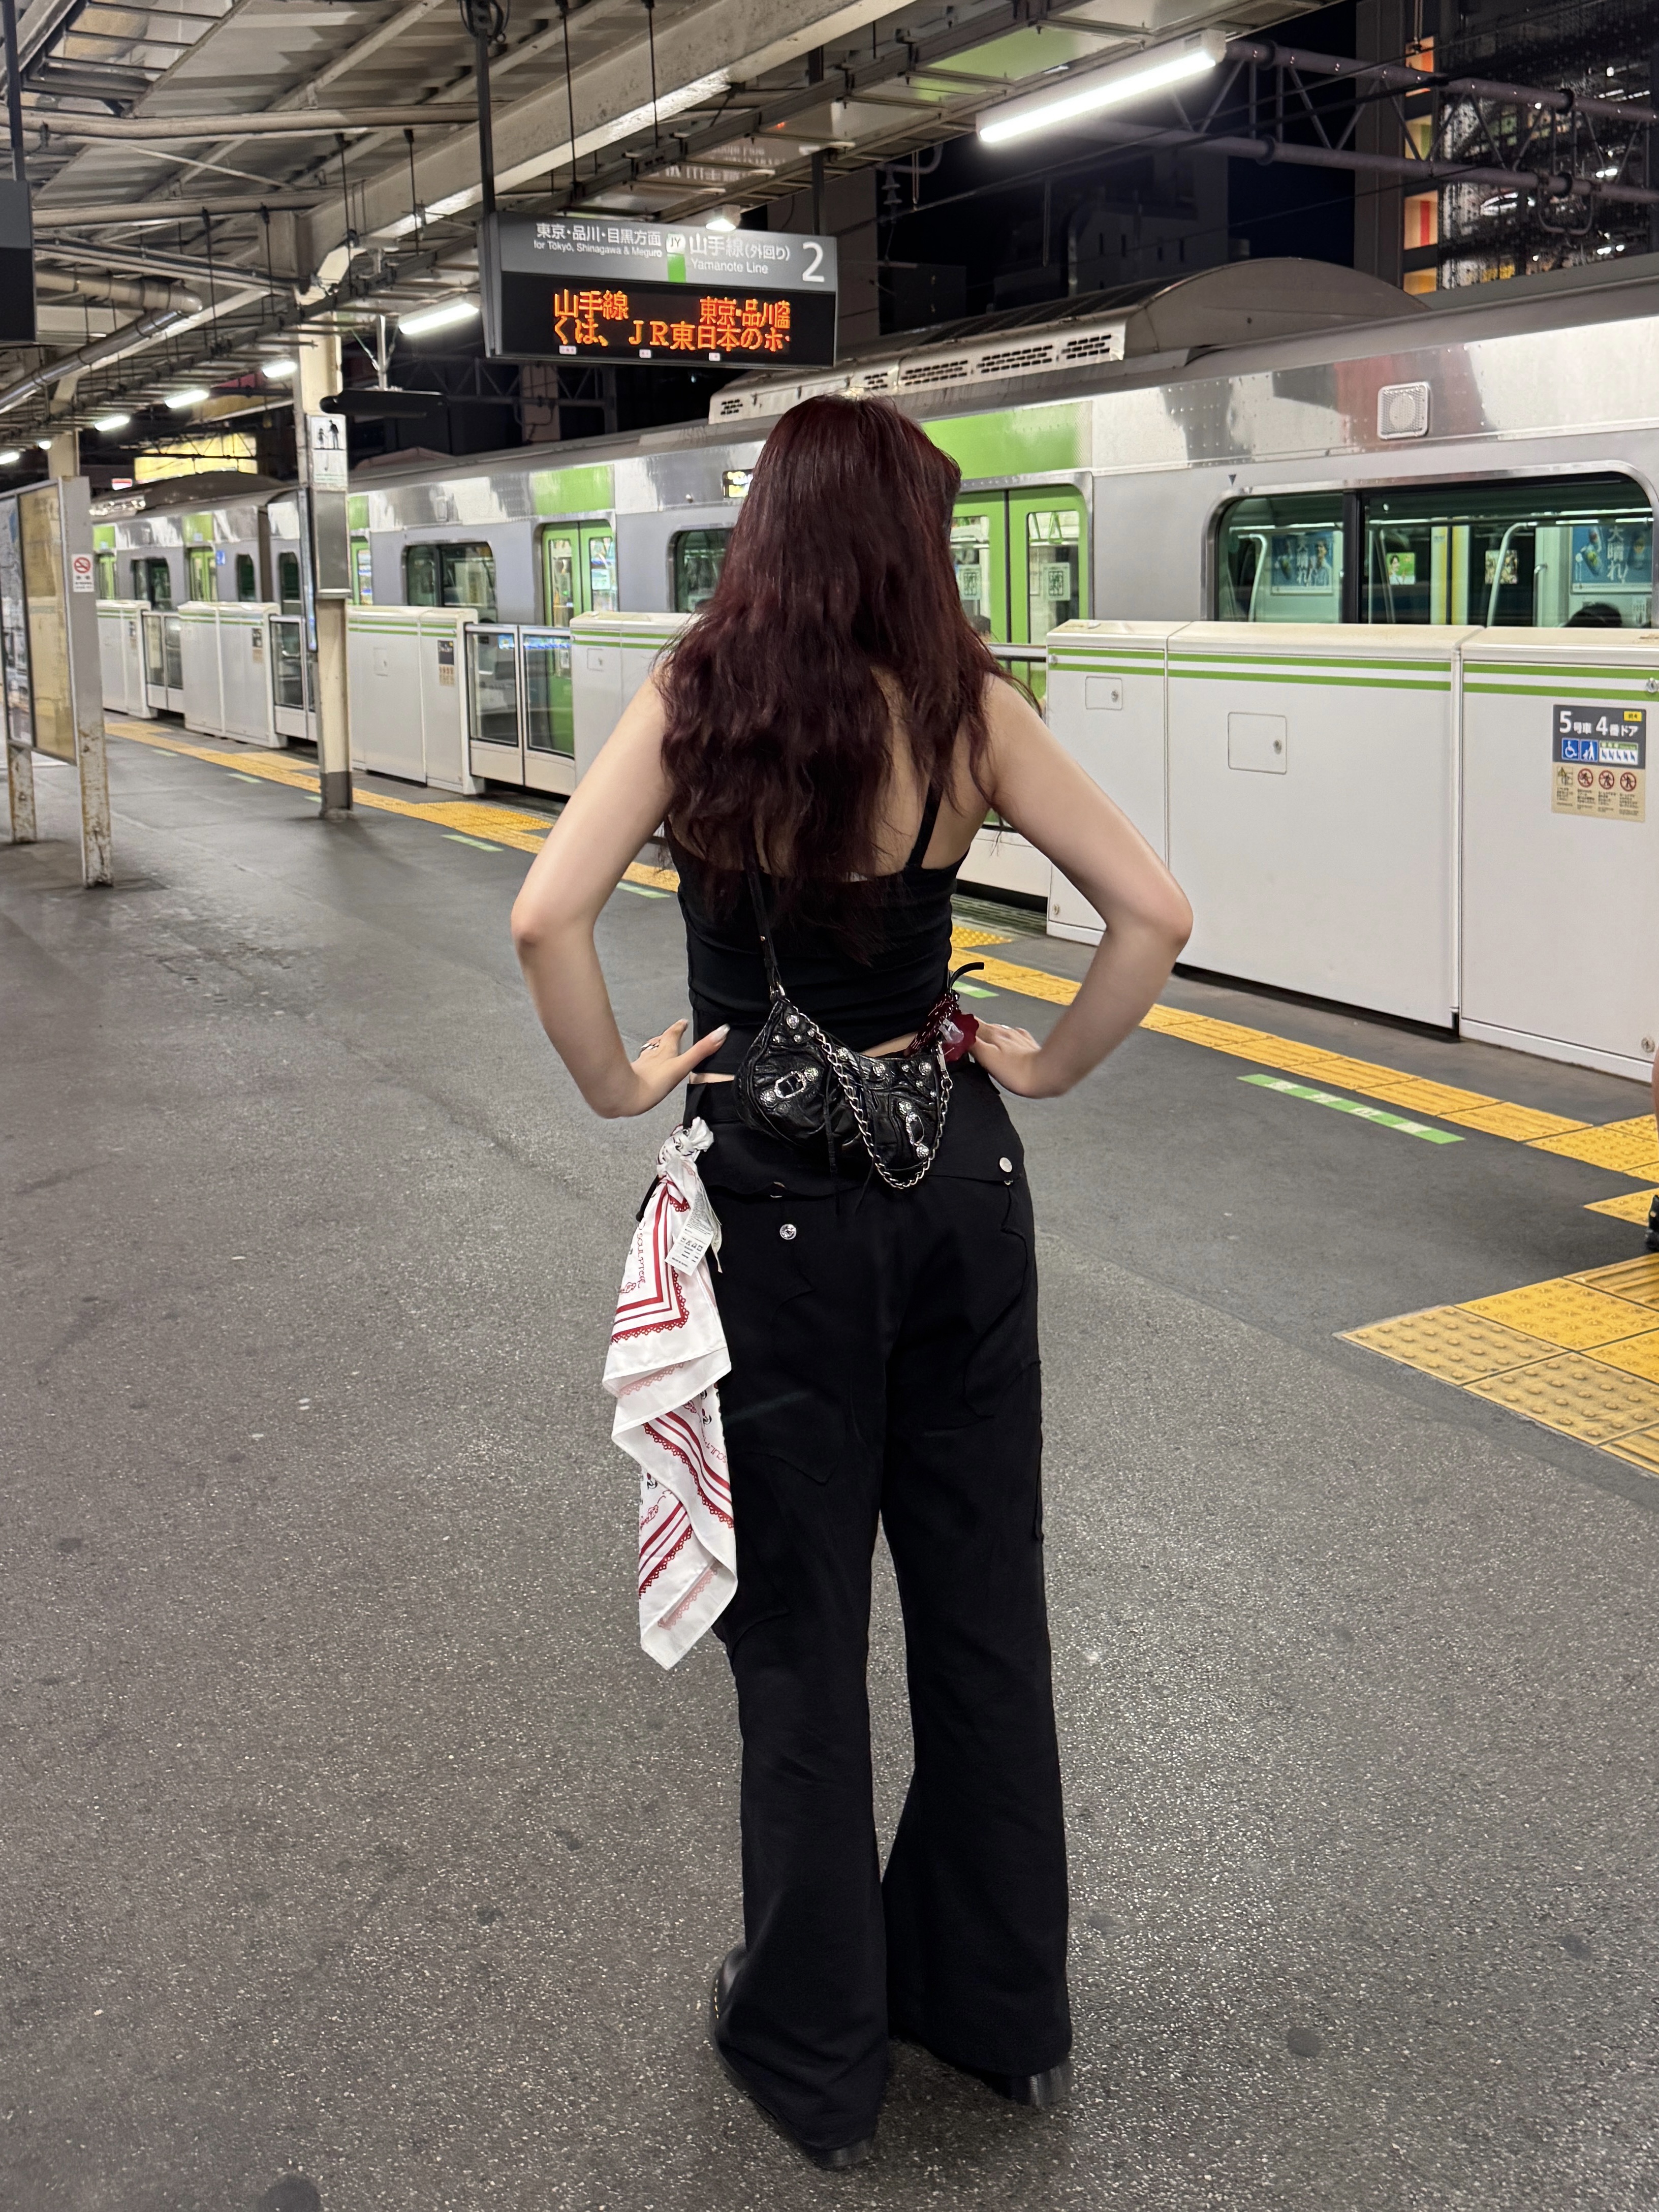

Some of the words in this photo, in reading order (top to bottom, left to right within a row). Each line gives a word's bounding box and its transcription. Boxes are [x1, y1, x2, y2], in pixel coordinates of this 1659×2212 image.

[536, 223, 661, 246] 東京・品川・目黒方面
[670, 237, 681, 248] JY
[534, 240, 545, 249] for
[576, 242, 621, 256] Shinagawa
[623, 246, 630, 255] &
[632, 247, 663, 259] Meguro
[691, 258, 744, 272] Yamanote
[746, 261, 769, 274] Line
[802, 241, 825, 283] 2
[554, 289, 629, 321] 山手線
